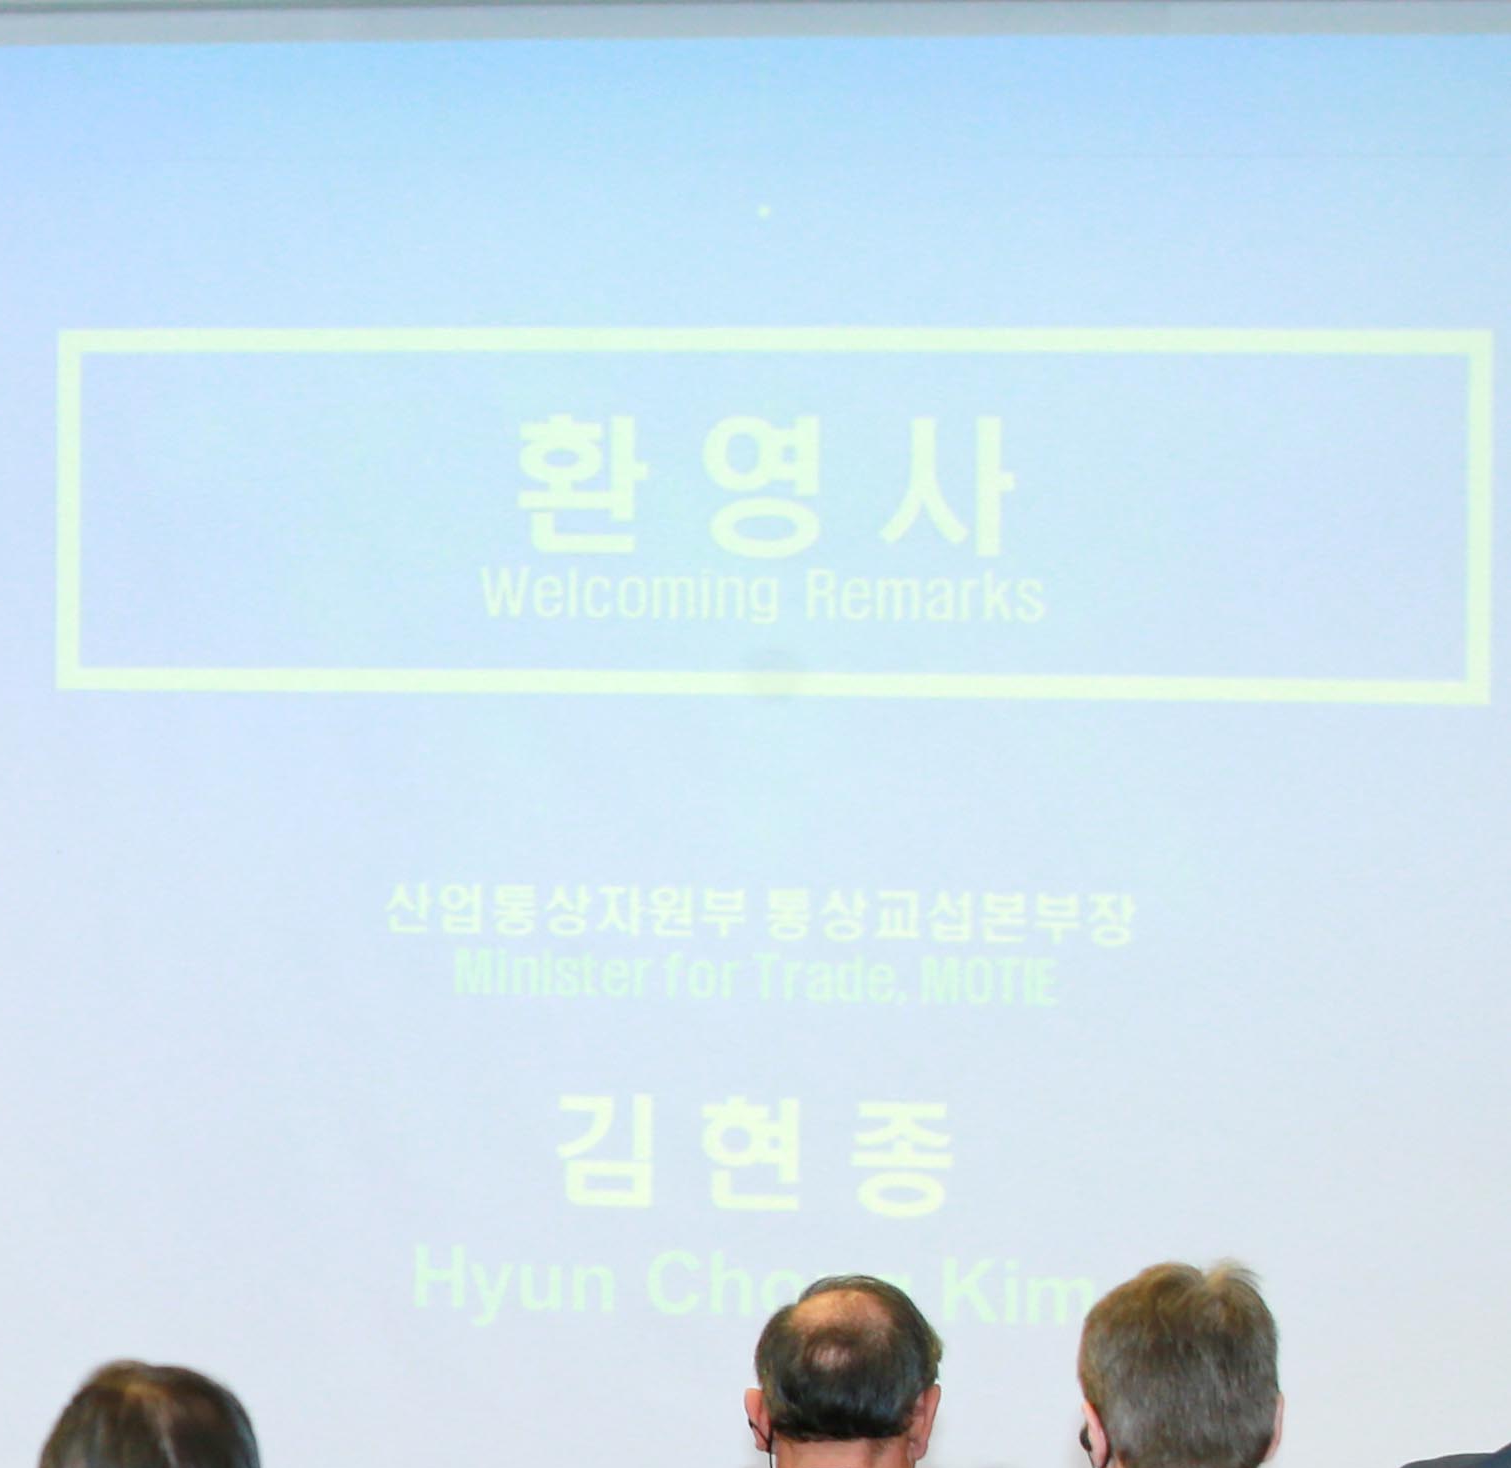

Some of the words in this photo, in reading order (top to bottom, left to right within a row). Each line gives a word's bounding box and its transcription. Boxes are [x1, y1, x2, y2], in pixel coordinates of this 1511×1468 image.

[478, 567, 779, 627] Welcoming
[804, 570, 1046, 624] Remarks
[381, 881, 749, 940] 산업통상자원부
[764, 885, 1138, 948] 통상교섭본부장
[451, 948, 651, 999] Minister
[664, 952, 739, 1000] for
[920, 957, 1060, 1008] MOTIE
[411, 1243, 615, 1327] Hyun
[645, 1250, 913, 1318] Cho
[940, 1257, 1096, 1325] Kim
